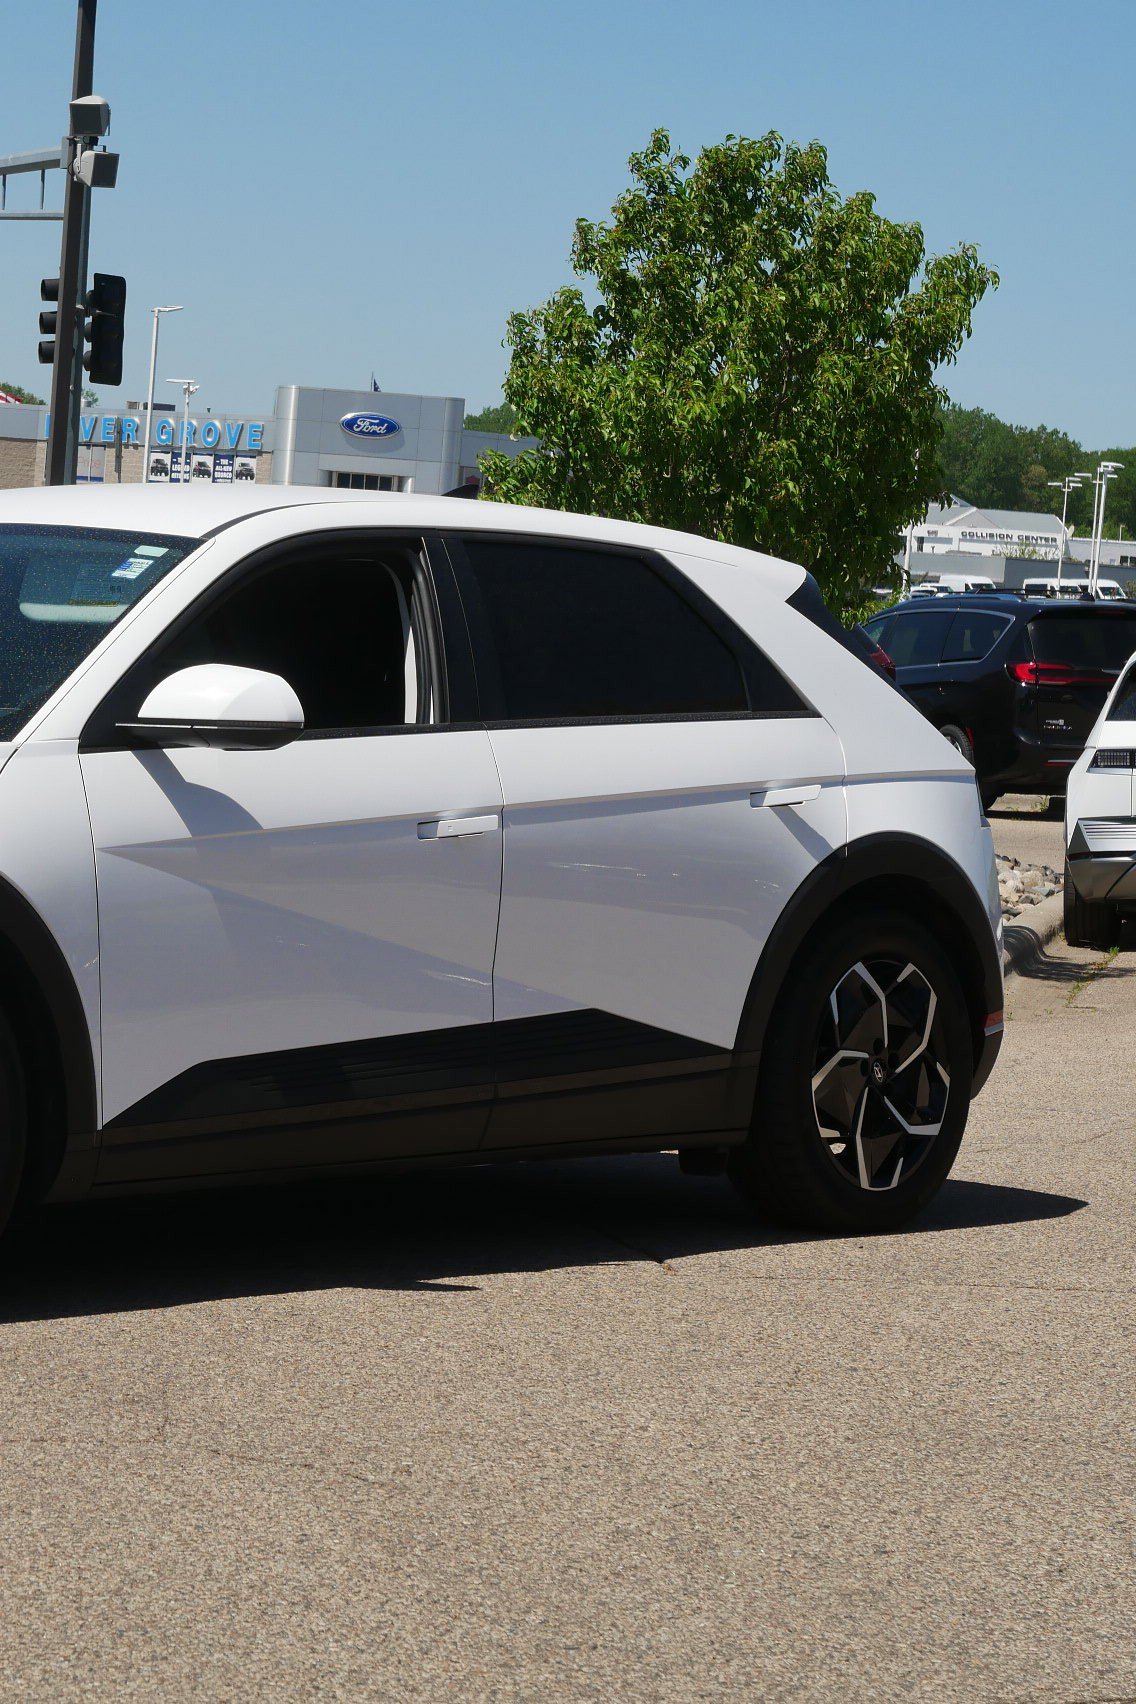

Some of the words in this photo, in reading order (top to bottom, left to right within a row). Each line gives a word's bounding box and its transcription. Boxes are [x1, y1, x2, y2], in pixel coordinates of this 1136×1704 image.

[45, 411, 140, 444] VER
[155, 418, 264, 450] GROVE
[353, 416, 387, 434] Ford
[961, 530, 1014, 541] COLLISION
[1017, 533, 1058, 544] CENTER
